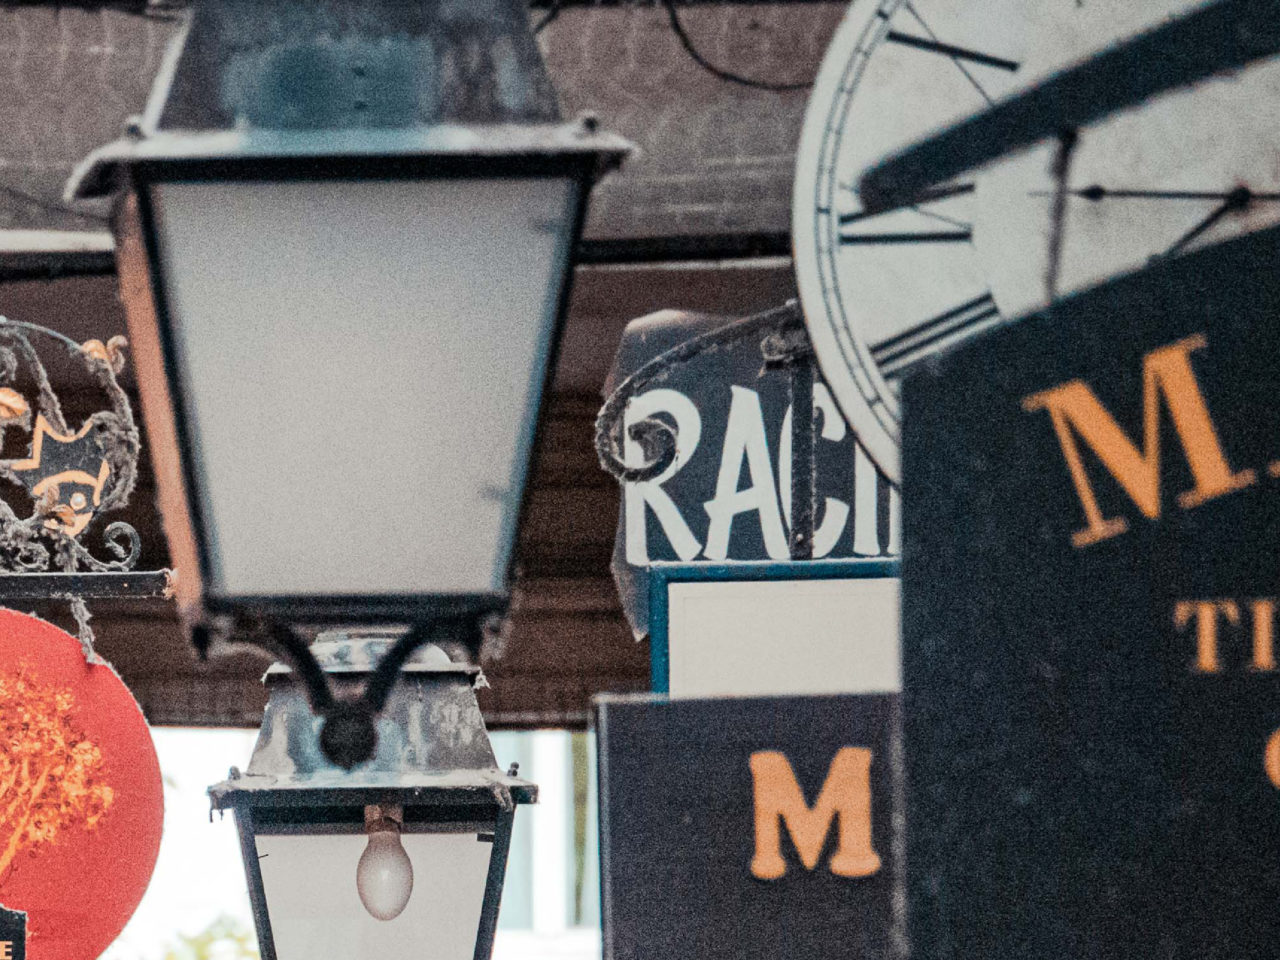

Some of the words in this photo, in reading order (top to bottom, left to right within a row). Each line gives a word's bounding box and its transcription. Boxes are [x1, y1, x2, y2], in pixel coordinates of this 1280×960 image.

[623, 384, 902, 567] RACI
[1023, 333, 1280, 548] M
[749, 746, 883, 879] M
